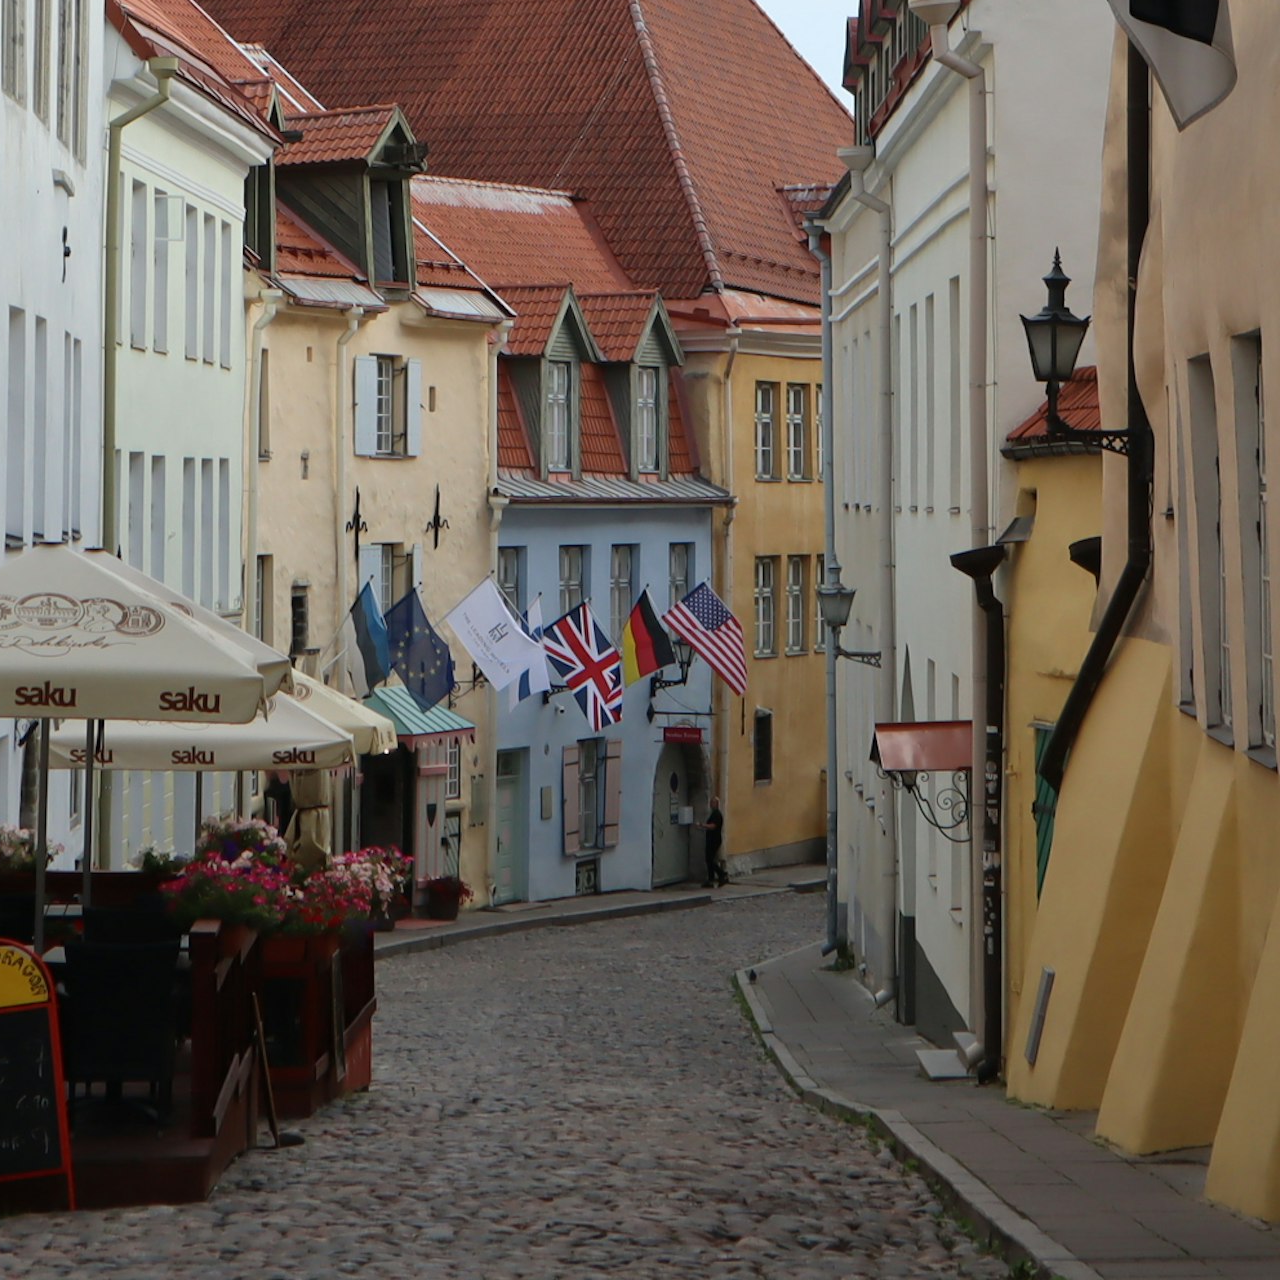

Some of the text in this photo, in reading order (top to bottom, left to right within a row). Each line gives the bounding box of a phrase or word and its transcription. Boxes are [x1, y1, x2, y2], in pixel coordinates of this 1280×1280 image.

[14, 680, 77, 707] saku
[158, 686, 221, 713] saku
[171, 746, 215, 765] saku
[272, 746, 315, 765] saku
